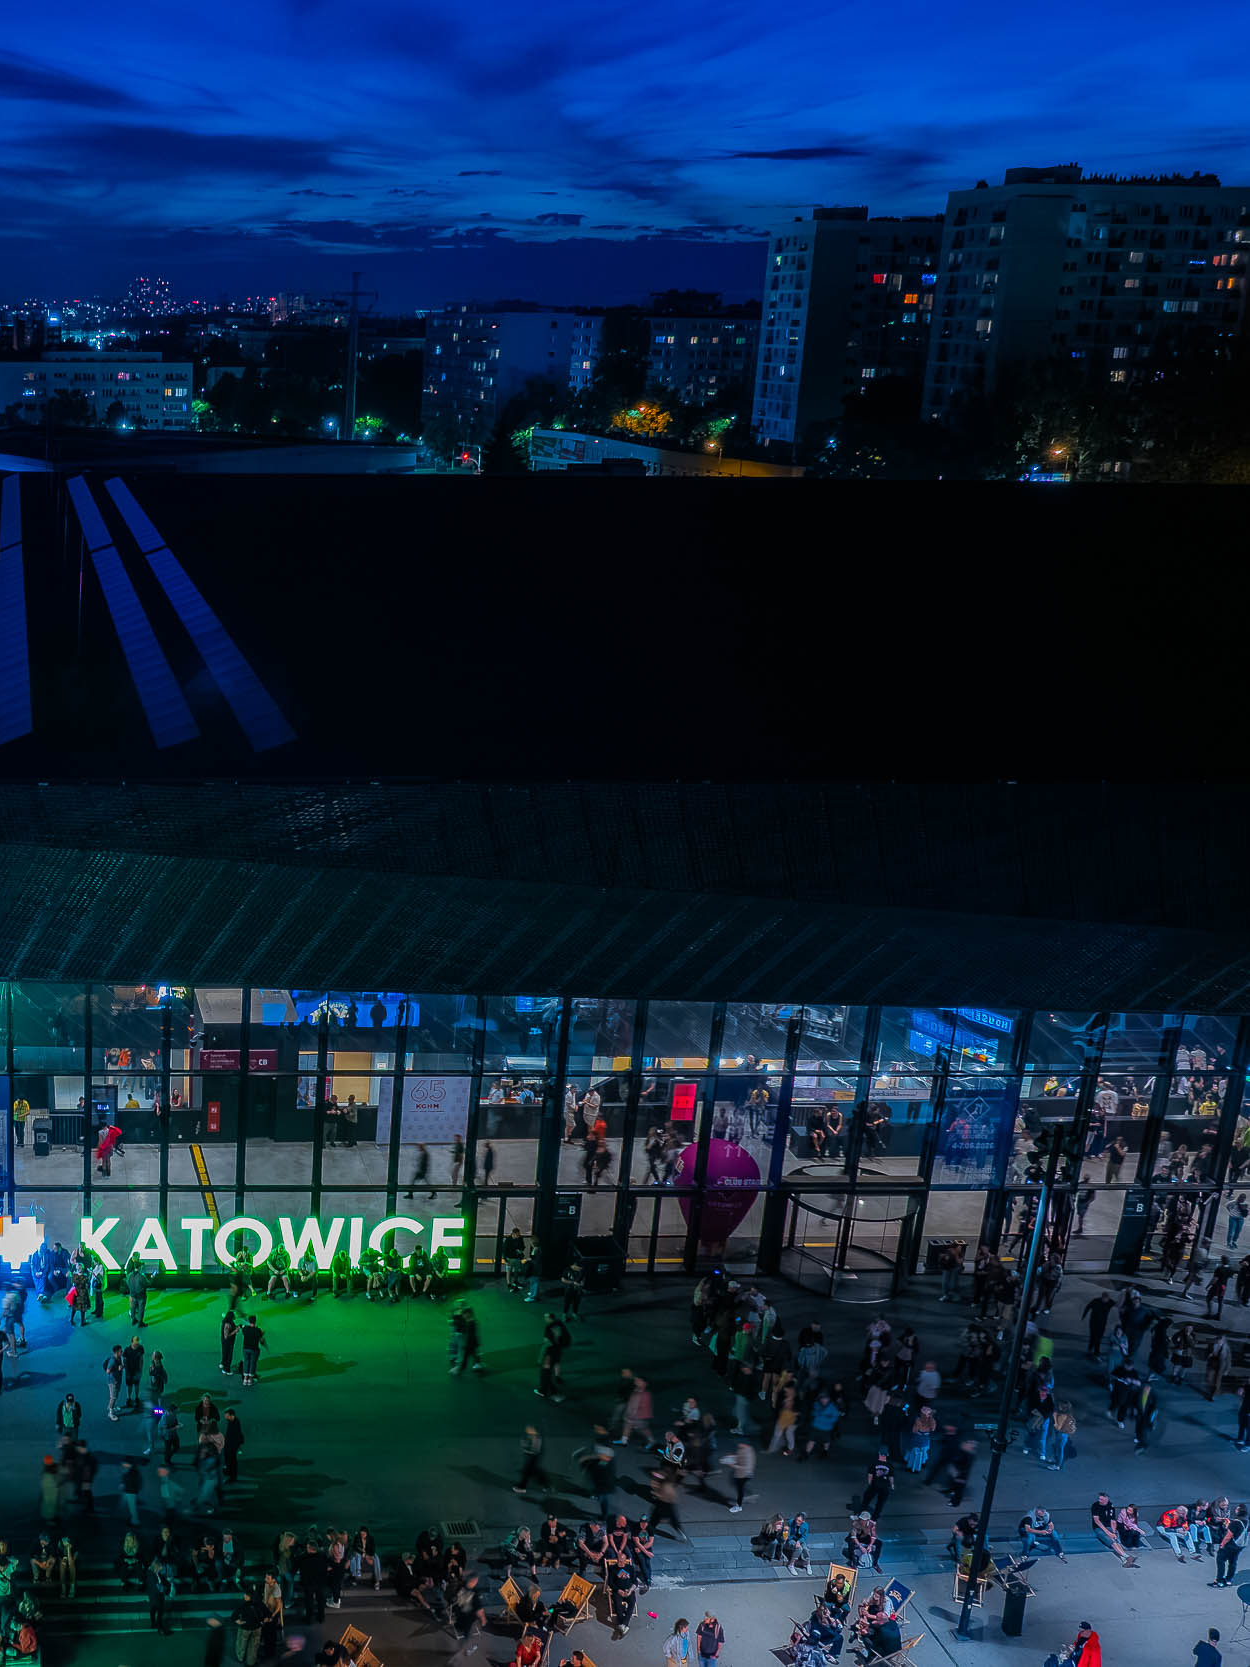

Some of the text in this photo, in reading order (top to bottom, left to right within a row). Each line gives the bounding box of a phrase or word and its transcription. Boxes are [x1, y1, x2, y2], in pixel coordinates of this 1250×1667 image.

[410, 1079, 447, 1103] 65
[568, 1205, 577, 1215] B
[1135, 1203, 1145, 1212] B
[80, 1217, 466, 1270] KATOWICE
